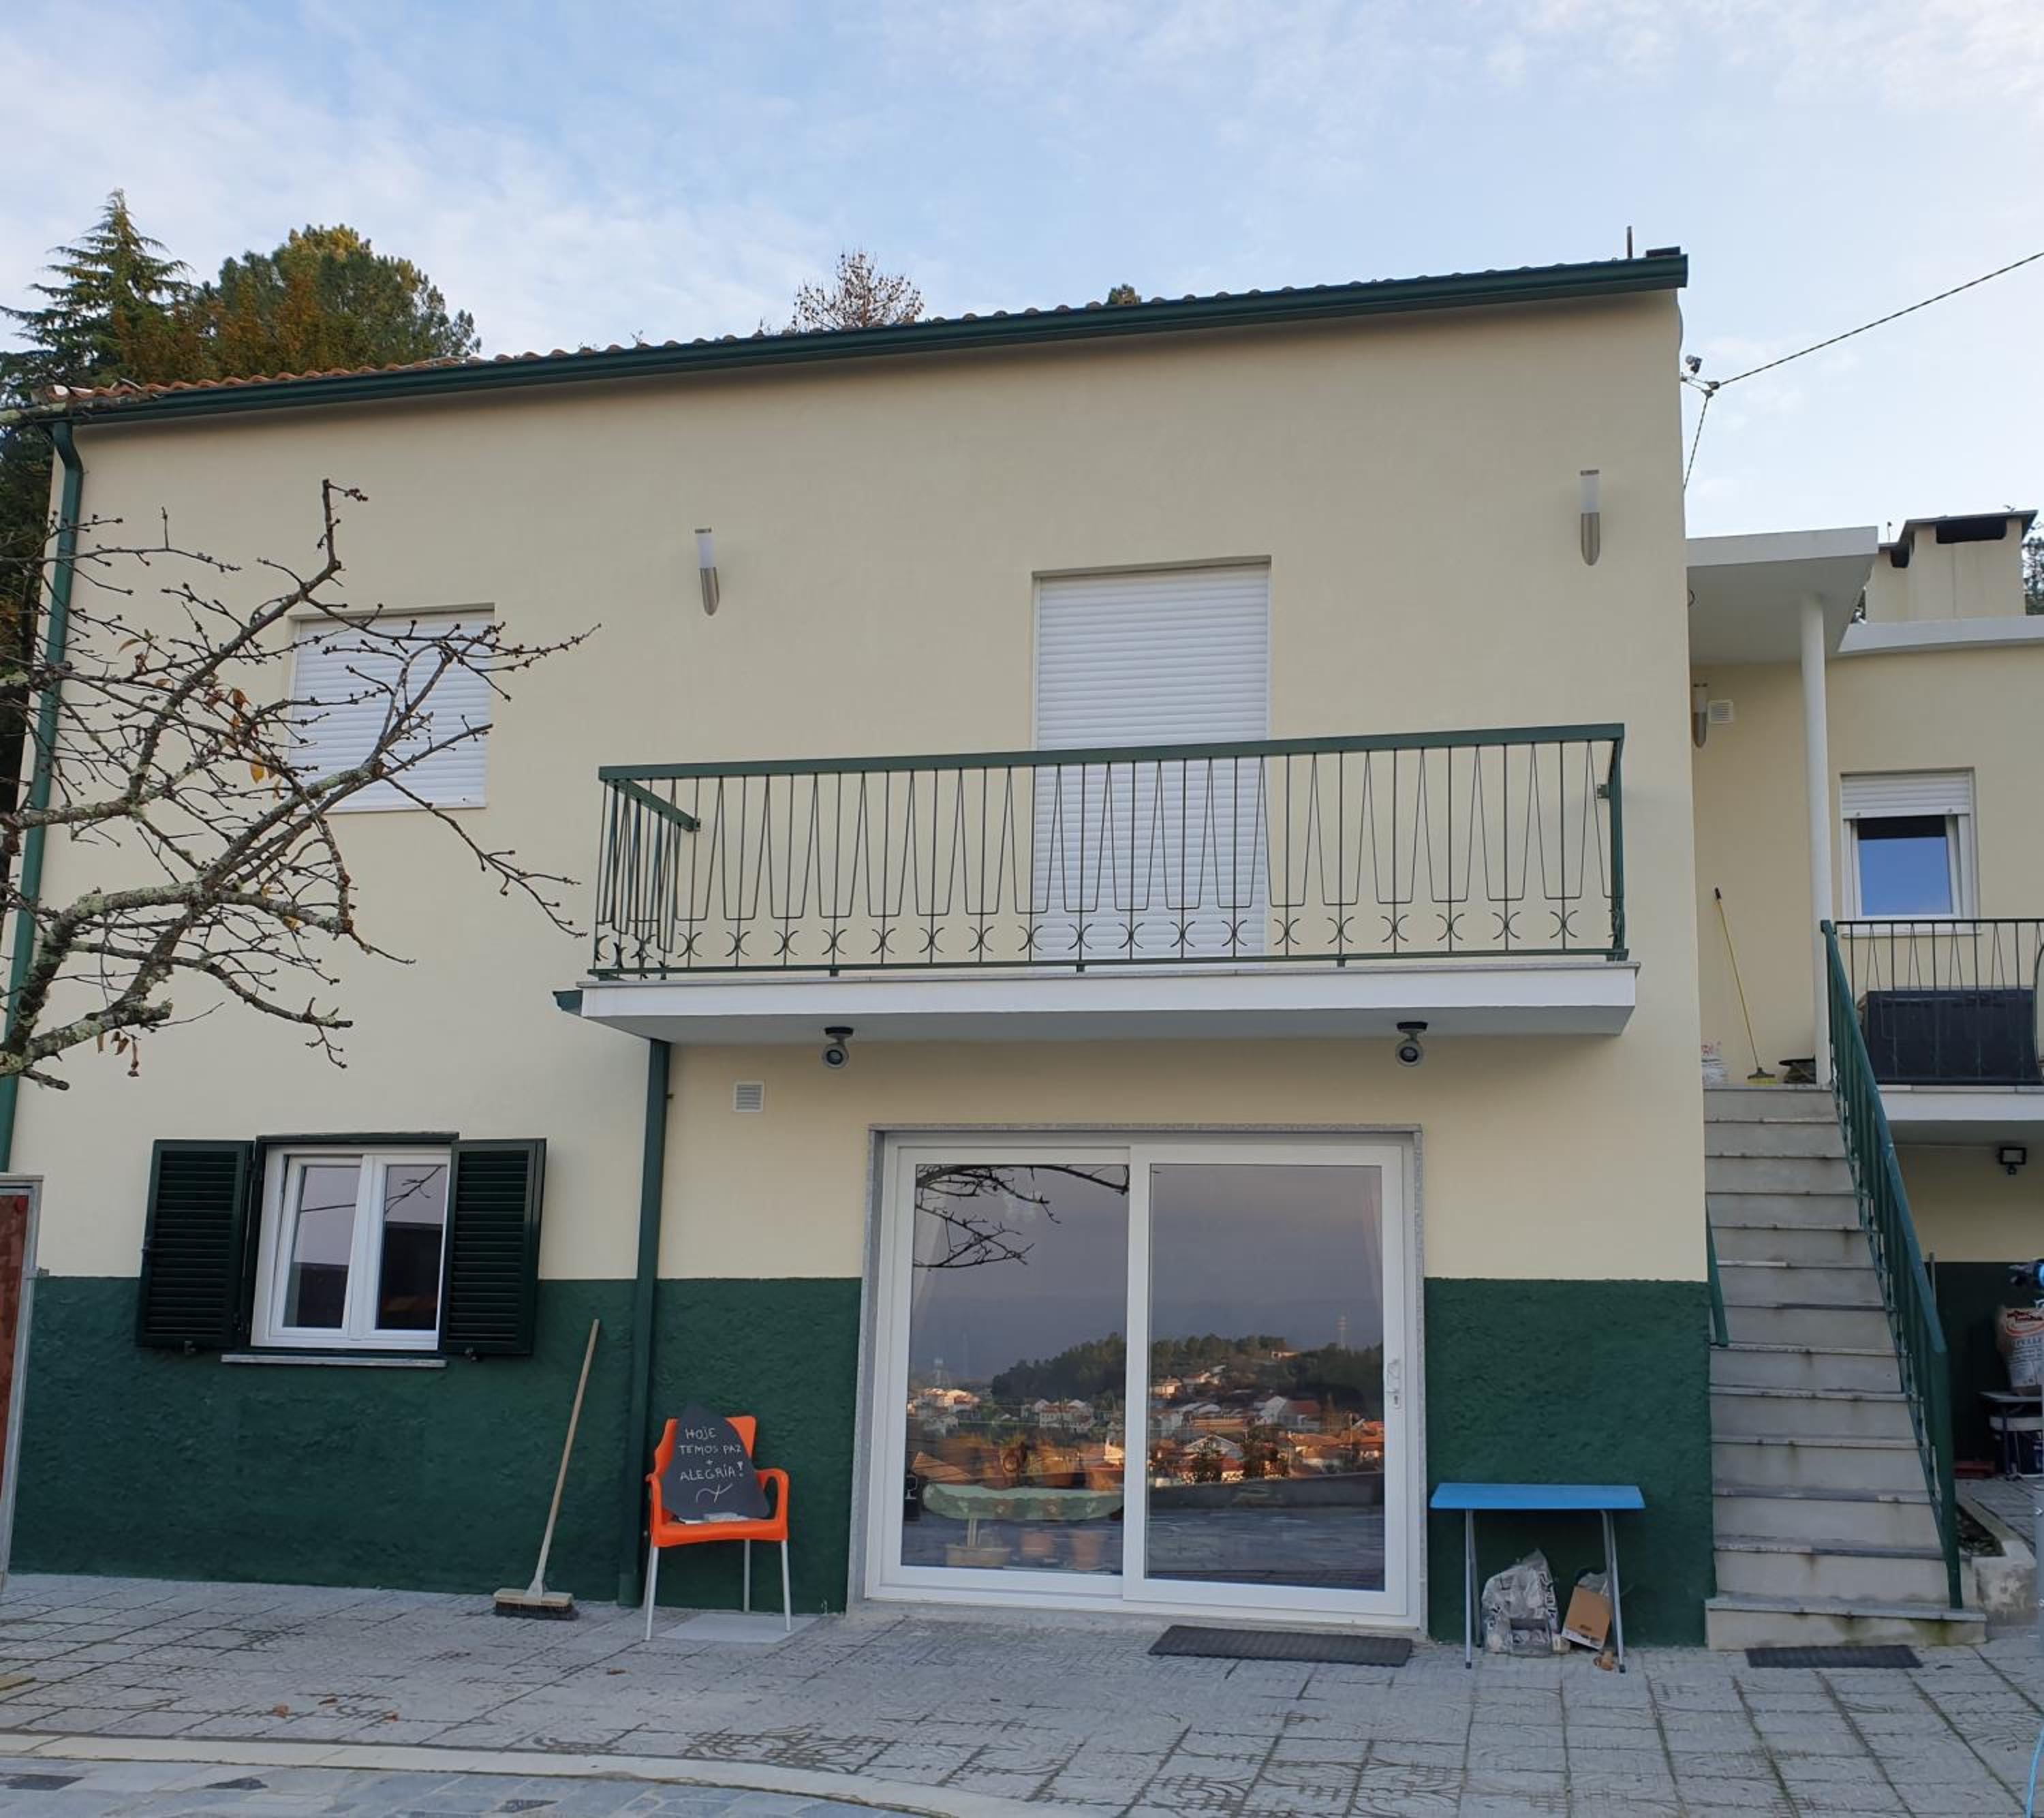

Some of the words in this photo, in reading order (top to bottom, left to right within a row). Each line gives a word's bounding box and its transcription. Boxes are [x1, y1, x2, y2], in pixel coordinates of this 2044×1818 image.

[685, 1428, 716, 1440] HOJE
[679, 1445, 718, 1455] TEMOS
[723, 1445, 741, 1455] PAZ
